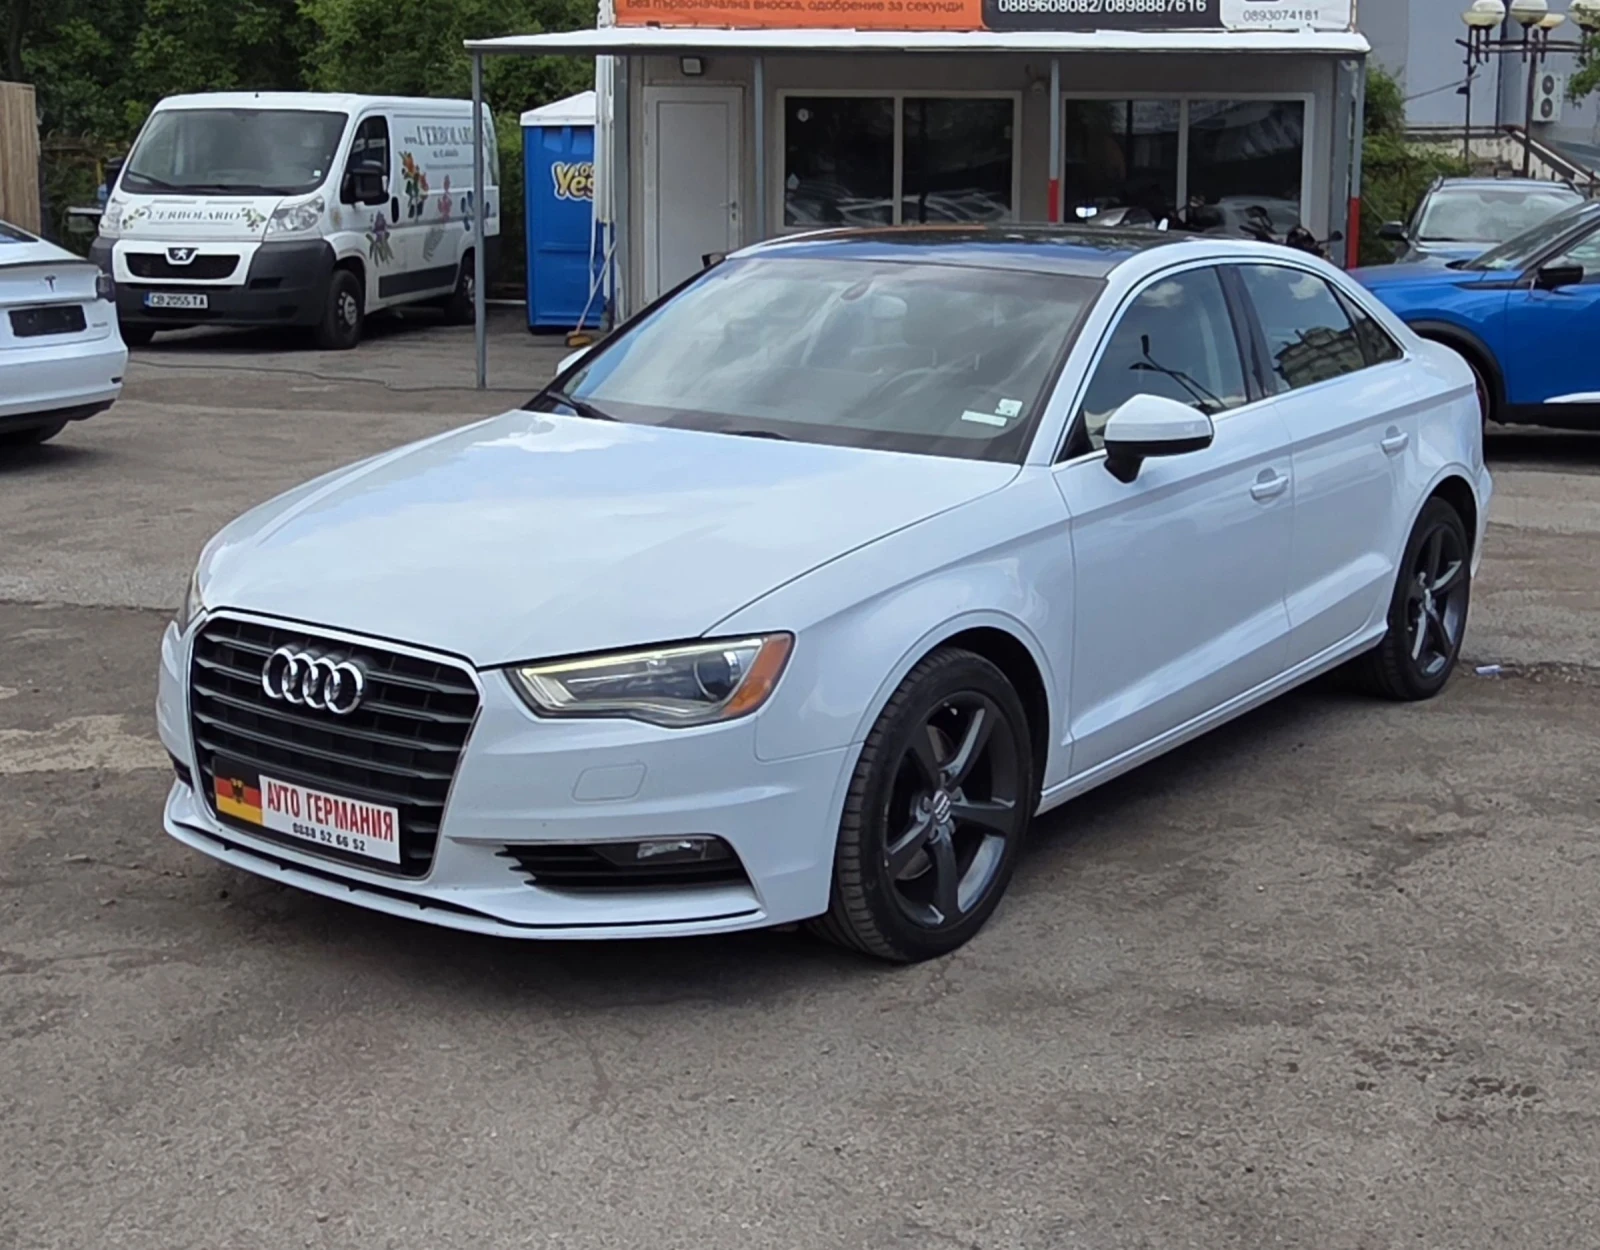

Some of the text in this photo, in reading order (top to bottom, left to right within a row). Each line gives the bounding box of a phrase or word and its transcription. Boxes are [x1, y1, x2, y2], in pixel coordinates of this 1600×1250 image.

[807, 0, 884, 12] одобрение
[887, 1, 903, 11] за
[906, 1, 964, 13] секунди
[1243, 10, 1319, 21] 0893074181
[267, 781, 394, 842] АУТО ГЕРМАНИЯ
[320, 830, 333, 843] 52
[352, 839, 365, 852] 52
